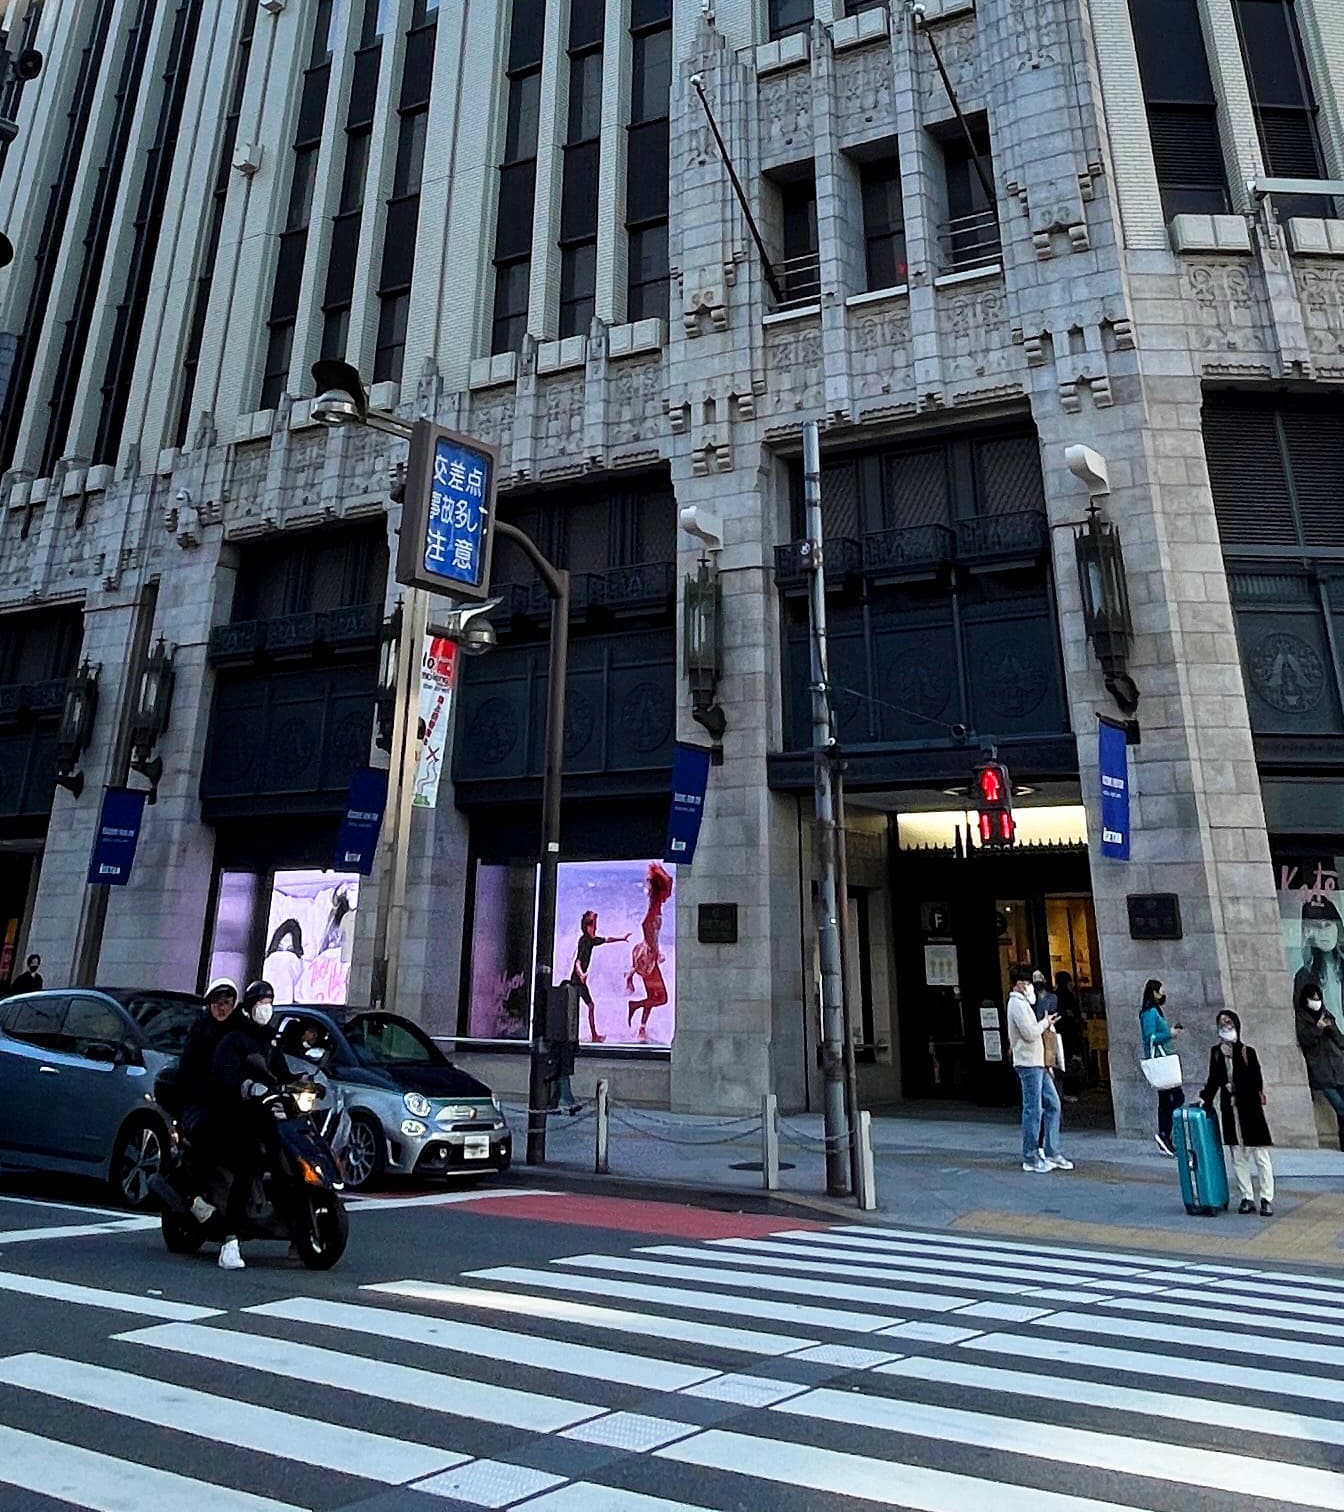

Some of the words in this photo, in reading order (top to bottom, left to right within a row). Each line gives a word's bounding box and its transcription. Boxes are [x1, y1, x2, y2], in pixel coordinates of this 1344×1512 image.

[433, 453, 484, 498] 交差点
[425, 527, 474, 571] 注意
